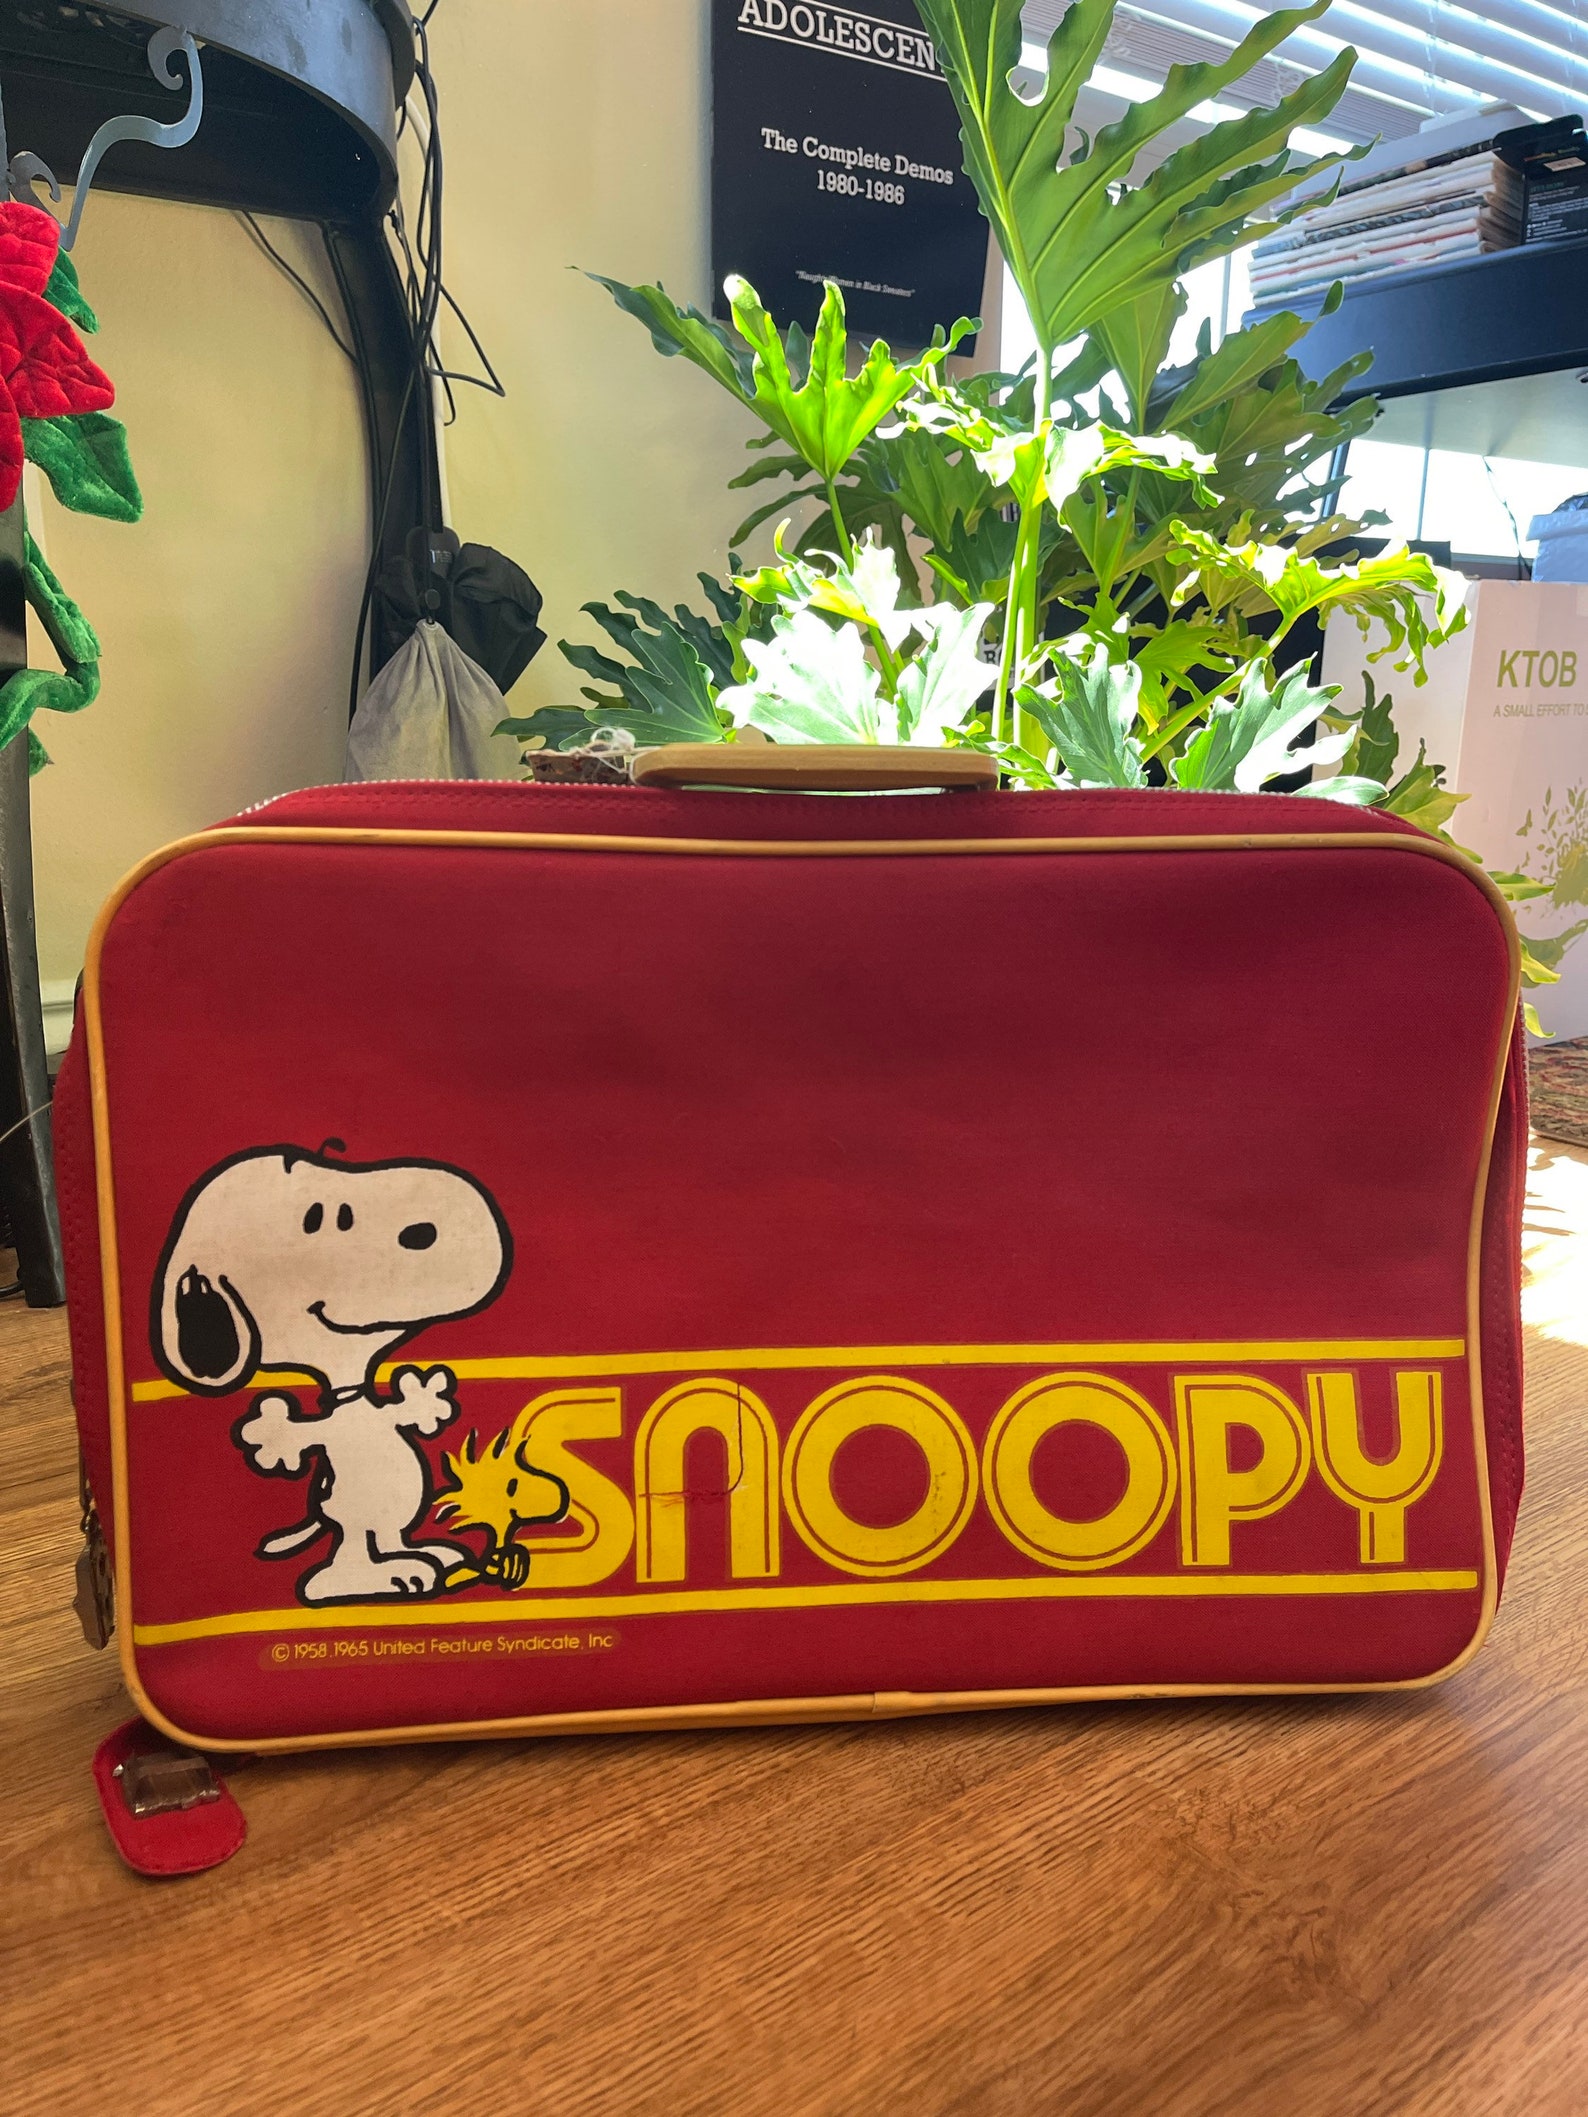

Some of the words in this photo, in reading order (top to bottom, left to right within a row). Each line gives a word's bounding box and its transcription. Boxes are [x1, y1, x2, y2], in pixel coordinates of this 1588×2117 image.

[737, 0, 944, 73] ADOLESCEN
[761, 127, 798, 153] The
[802, 136, 891, 172] Complete
[894, 154, 953, 185] Demos
[816, 169, 905, 205] 1980-1986
[1497, 650, 1577, 688] KTOB
[1493, 704, 1501, 717] A
[1503, 704, 1534, 718] SMALL
[1536, 703, 1570, 717] EFFORT
[1571, 703, 1584, 716] TO
[508, 1370, 1442, 1588] SNOOPY
[373, 1640, 425, 1656] United
[430, 1638, 493, 1653] Feature
[588, 1633, 613, 1648] Inc
